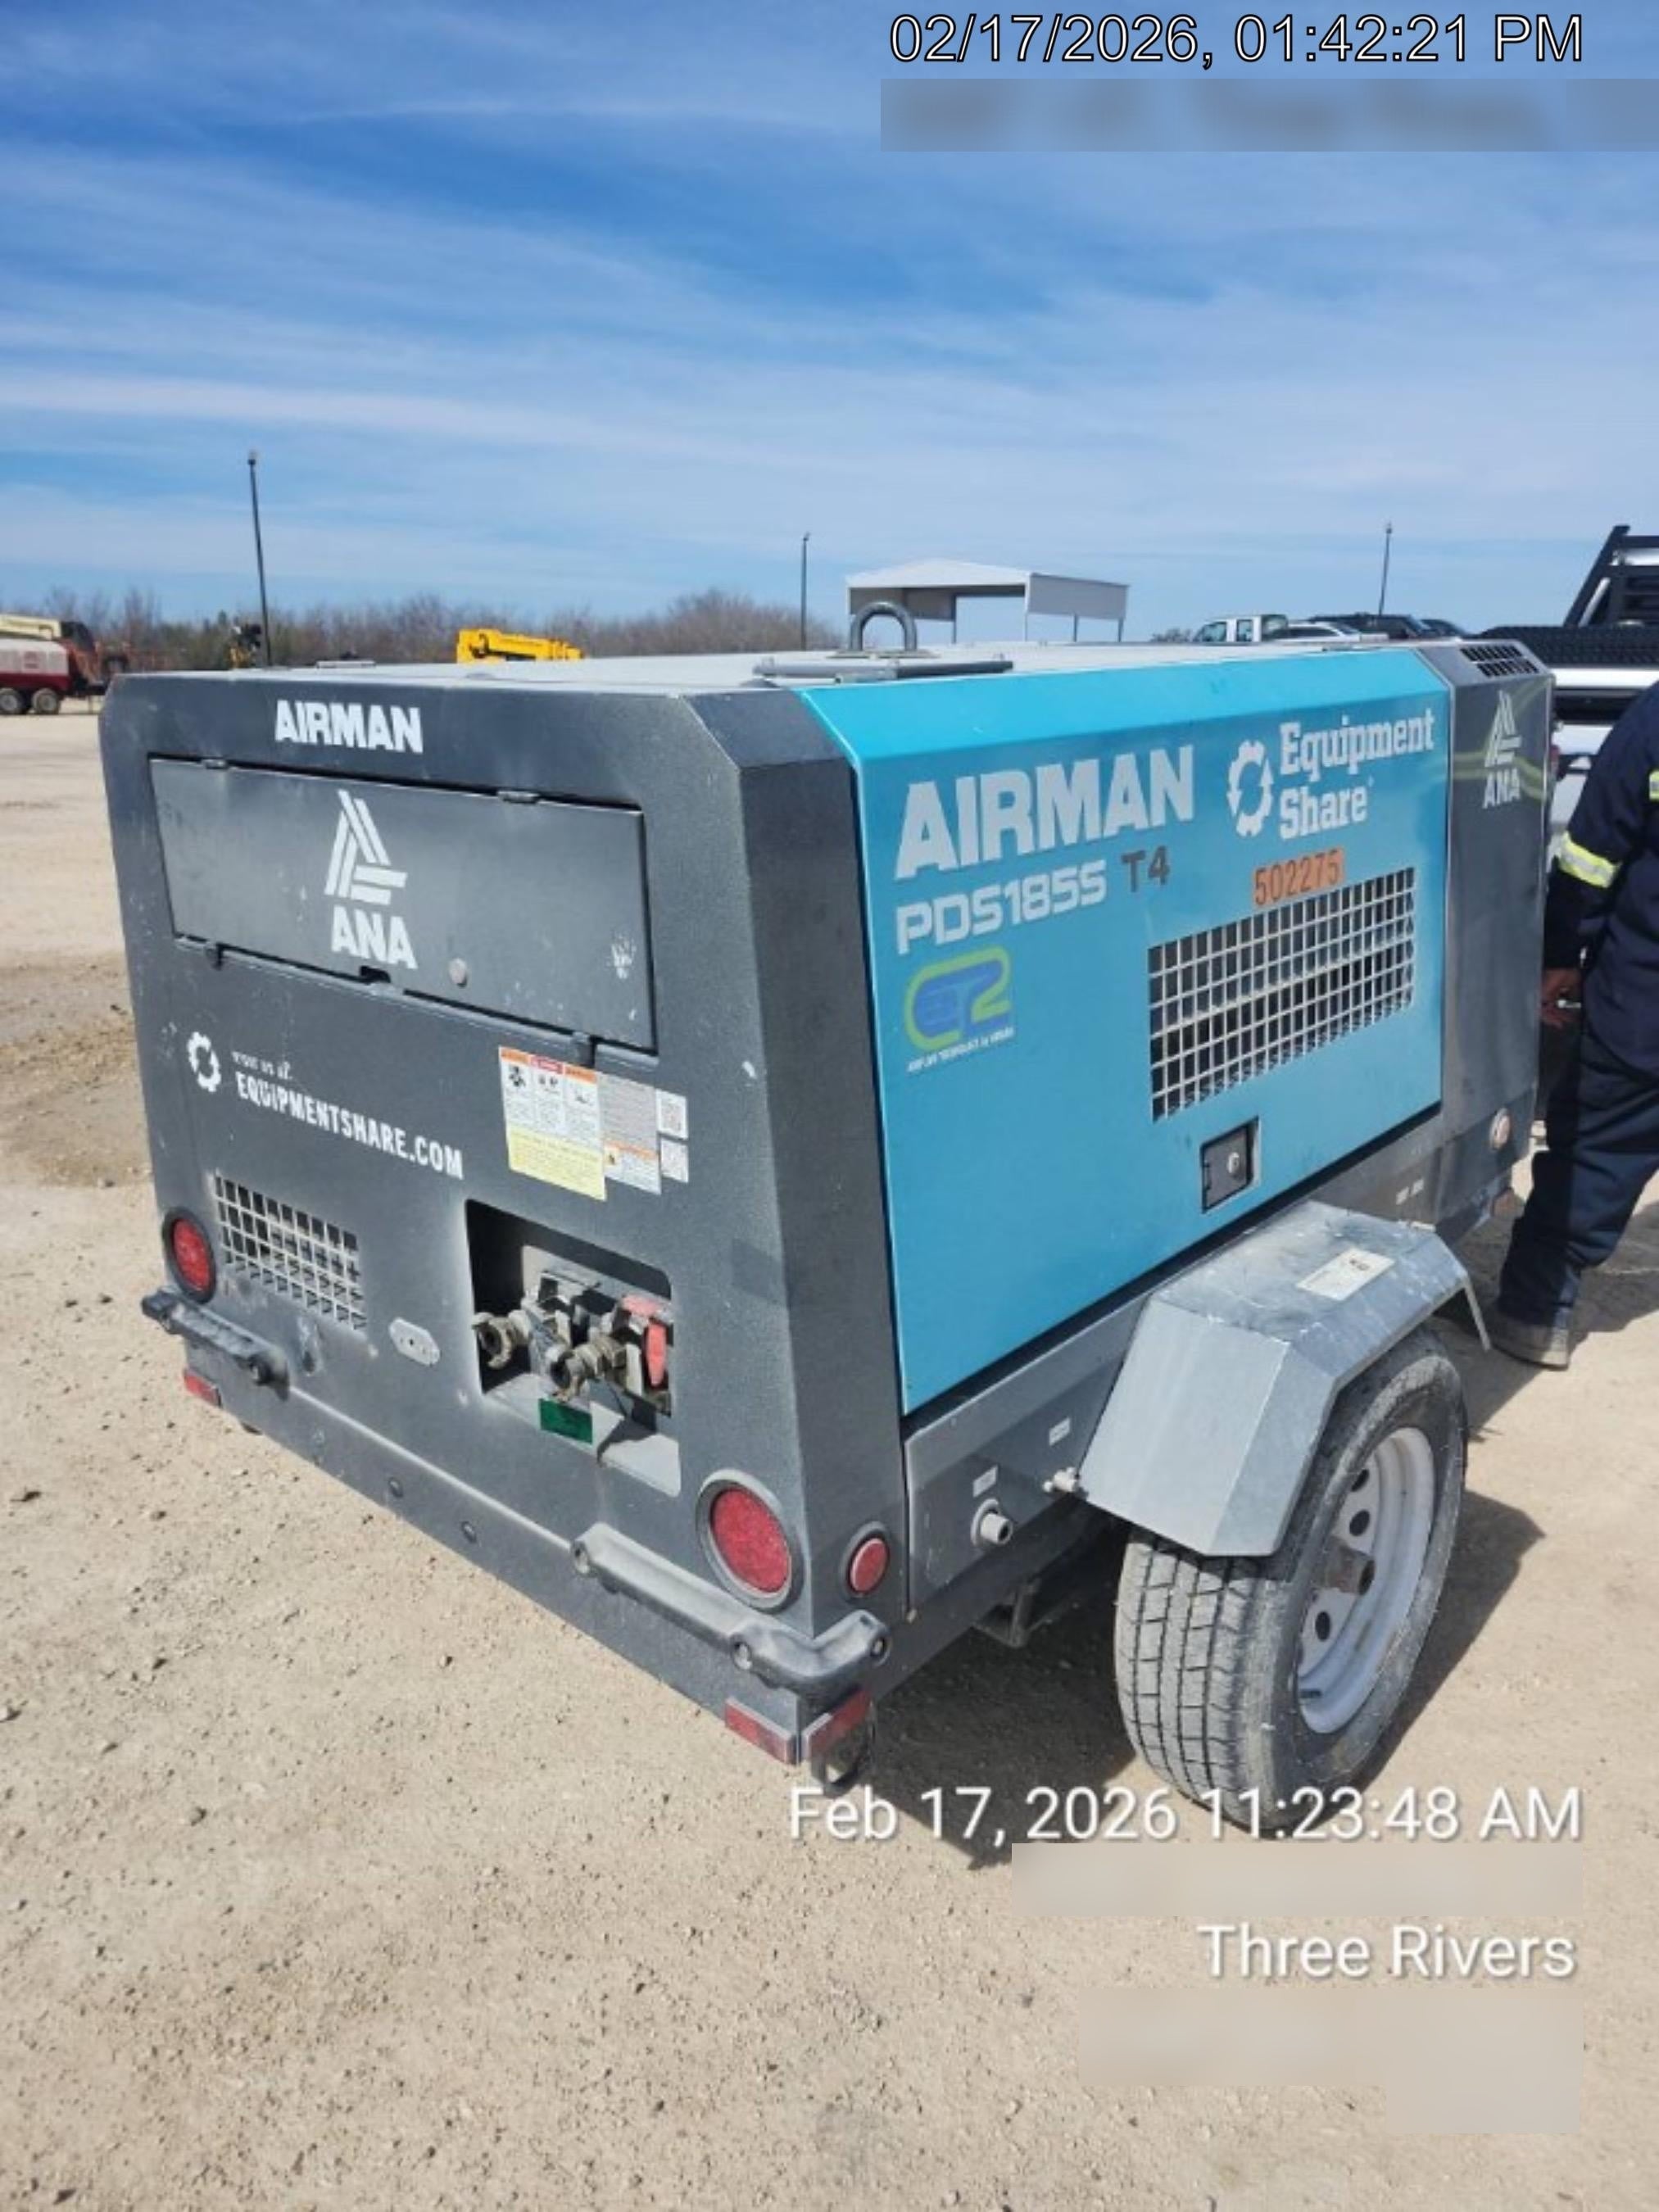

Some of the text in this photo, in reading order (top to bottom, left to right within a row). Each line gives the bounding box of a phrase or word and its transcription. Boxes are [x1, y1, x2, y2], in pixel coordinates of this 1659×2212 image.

[274, 700, 423, 753] AIRMAN
[1280, 708, 1435, 782] Equipment
[895, 744, 1194, 881] AIRMAN
[1280, 785, 1368, 841] Share
[1482, 768, 1521, 809] ANA
[896, 845, 1171, 956] PDS185S T4
[1254, 847, 1342, 906] 502275
[331, 906, 419, 969] ANA
[235, 1071, 464, 1180] EQUIPMENTSHARE.COM
